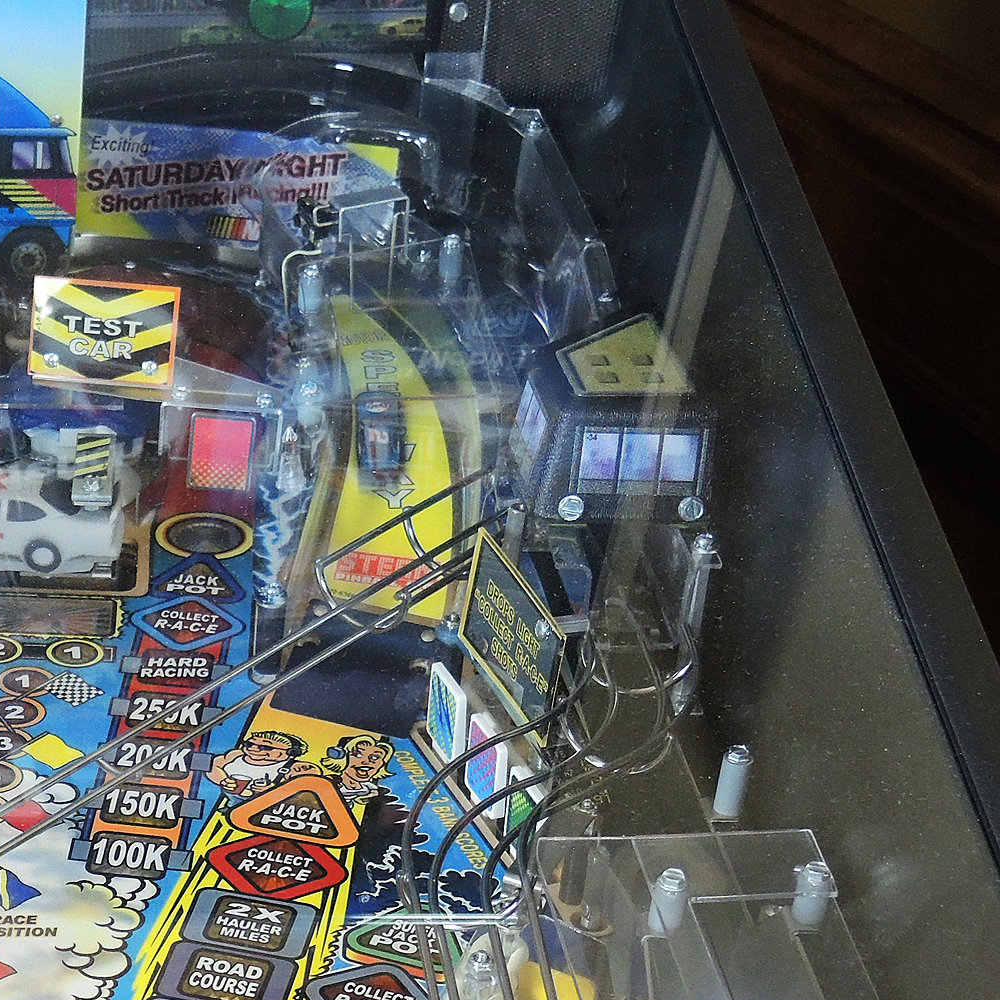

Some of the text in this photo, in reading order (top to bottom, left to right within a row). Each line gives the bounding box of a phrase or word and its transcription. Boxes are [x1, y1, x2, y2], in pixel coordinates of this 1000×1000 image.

[85, 158, 241, 191] SATURDAY
[100, 187, 225, 213] Short Track
[64, 315, 143, 338] TEST
[69, 338, 133, 361] CAR
[166, 584, 225, 595] POT
[174, 574, 220, 587] JACK
[154, 618, 218, 634] R-A-C-E
[160, 610, 219, 624] COLLECT
[487, 579, 541, 660] DROPS LIGHT
[63, 646, 81, 660] 1
[147, 656, 207, 668] HARD
[491, 637, 518, 682] SHOTS
[14, 674, 31, 688] 1
[140, 667, 209, 679] RACING
[4, 706, 25, 719] 2
[104, 788, 180, 819] 150K
[272, 801, 325, 821] JACK
[260, 817, 328, 834] POT
[92, 839, 169, 870] 100K
[247, 848, 313, 868] COLLECT
[237, 859, 312, 882] R-A-C-E
[224, 903, 285, 922] 2X
[216, 916, 282, 936] HAULER
[219, 927, 270, 944] MILES
[196, 956, 264, 979] ROAD
[188, 972, 258, 998] COURSE
